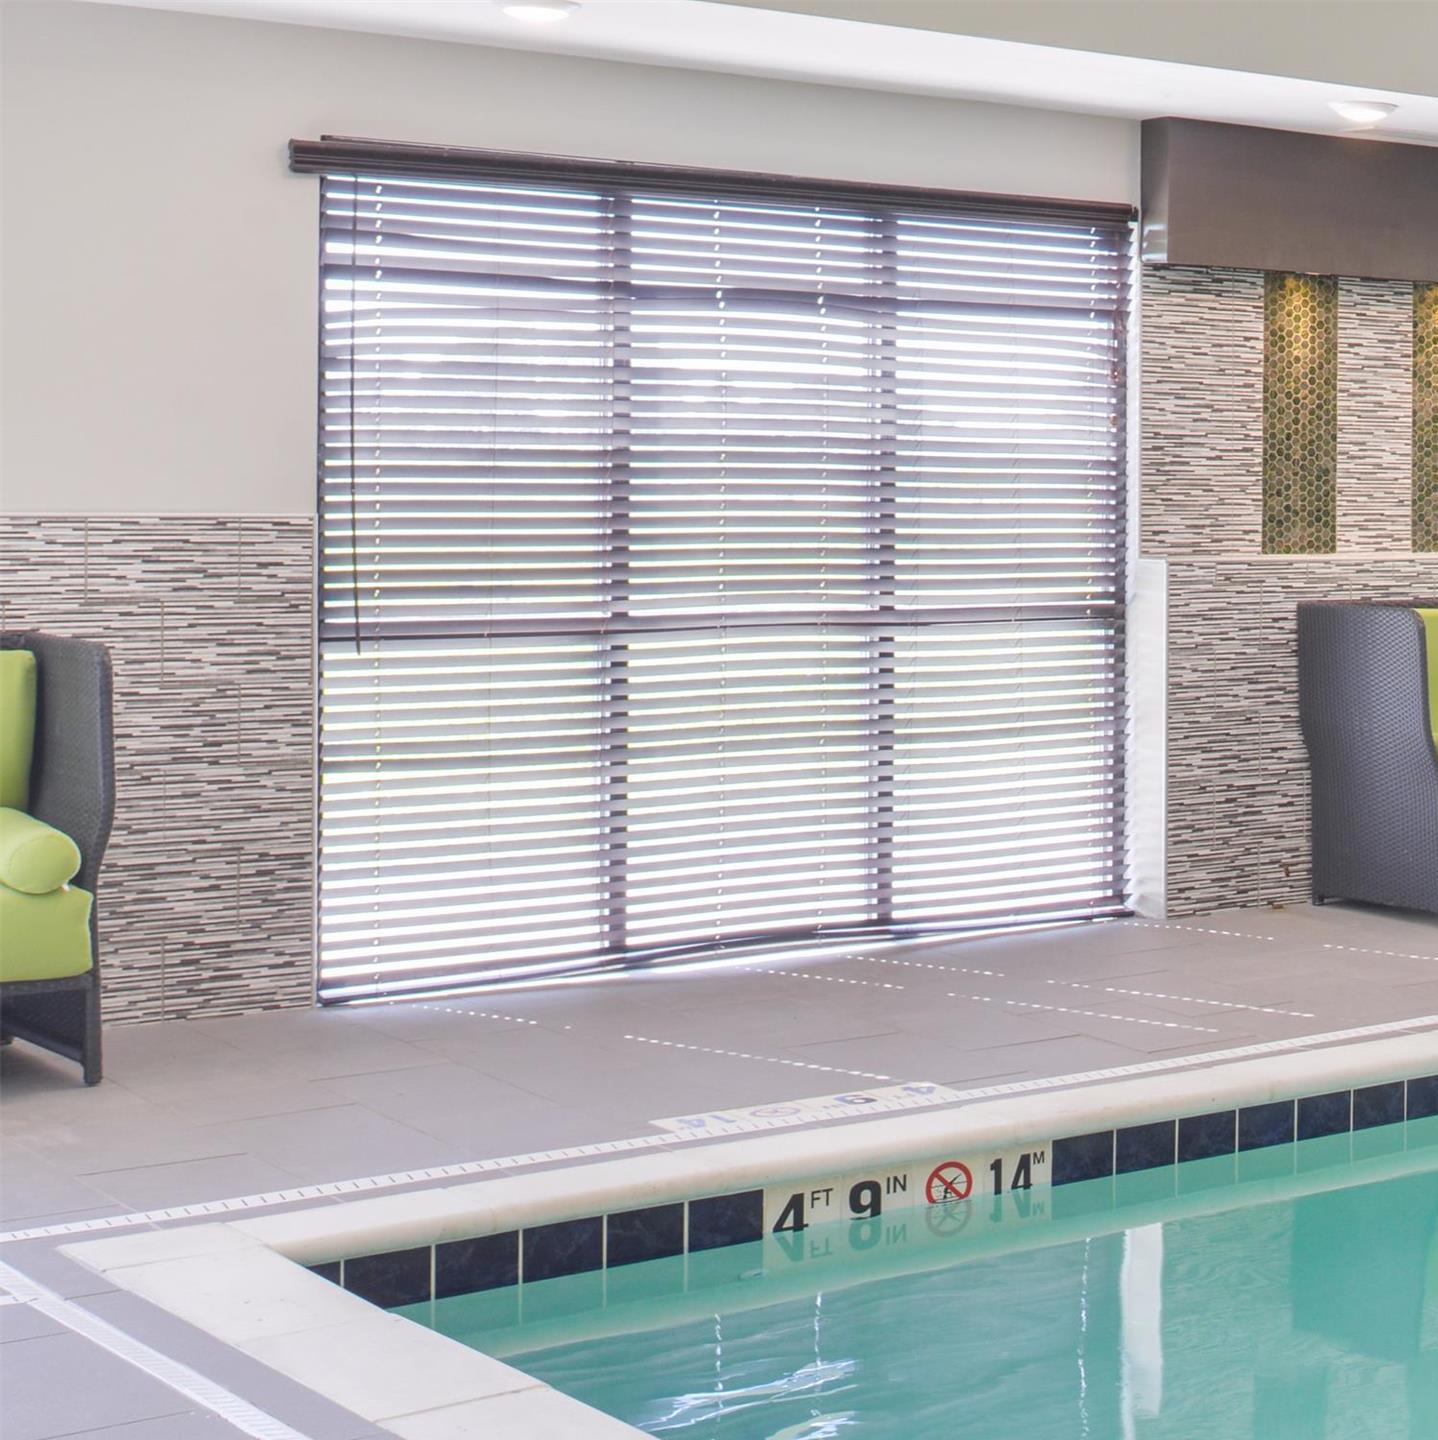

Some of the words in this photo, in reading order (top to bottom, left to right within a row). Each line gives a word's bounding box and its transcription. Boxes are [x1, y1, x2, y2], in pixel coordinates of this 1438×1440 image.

[772, 1193, 809, 1233] 4
[810, 1187, 834, 1209] FT
[849, 1180, 882, 1221] 9
[886, 1174, 907, 1195] IN
